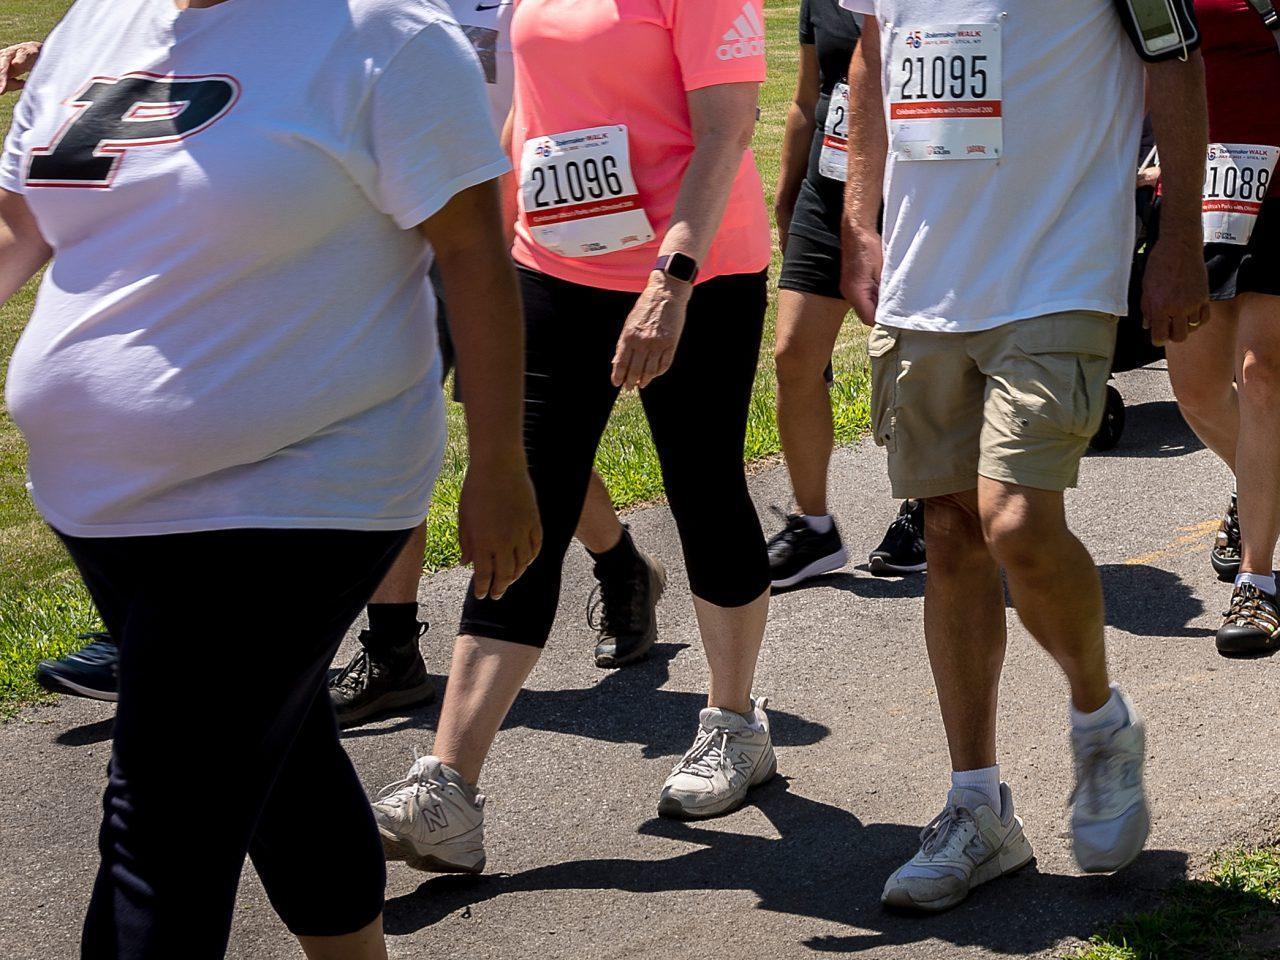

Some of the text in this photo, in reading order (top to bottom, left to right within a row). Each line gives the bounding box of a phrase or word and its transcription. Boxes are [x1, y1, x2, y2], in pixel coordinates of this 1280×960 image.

[900, 55, 988, 100] 21095
[25, 71, 242, 189] P
[832, 105, 849, 138] 2
[531, 155, 623, 208] 21096
[1201, 166, 1270, 202] 1088
